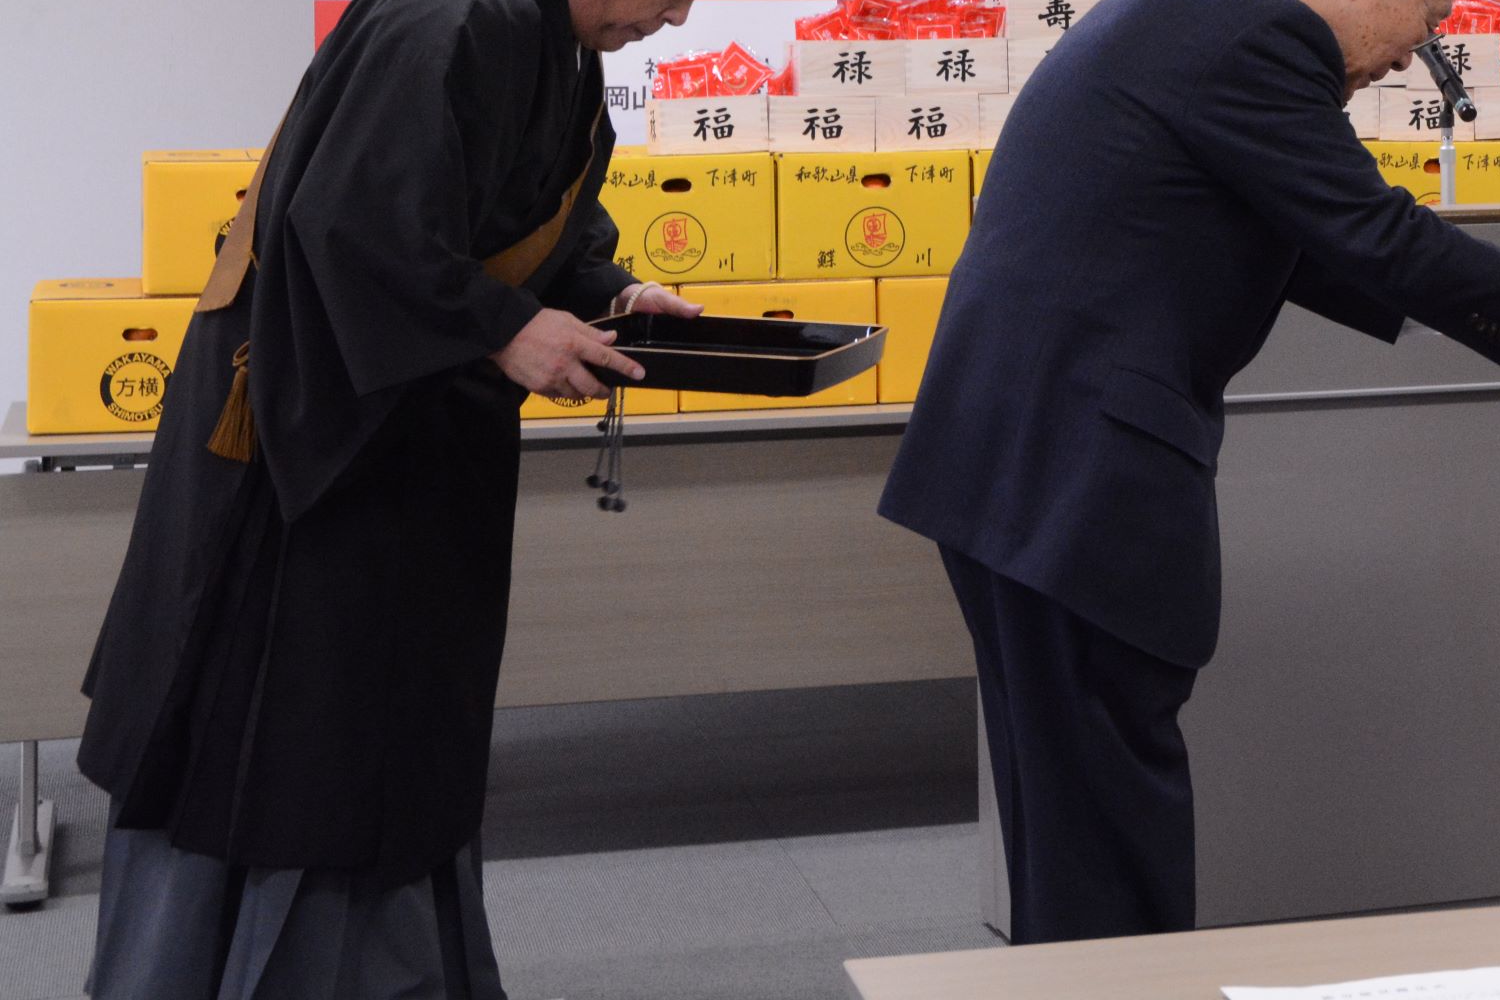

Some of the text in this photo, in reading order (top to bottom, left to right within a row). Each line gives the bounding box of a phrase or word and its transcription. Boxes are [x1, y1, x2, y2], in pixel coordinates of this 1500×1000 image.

[832, 50, 873, 85] 禄
[936, 49, 977, 83] 禄
[693, 107, 735, 142] 福
[802, 107, 844, 142] 福
[908, 106, 948, 141] 福
[795, 165, 955, 188] 和歌山県 下津町
[1375, 153, 1421, 170] 歌山県
[603, 168, 758, 188] 歌山県 下津町
[105, 352, 172, 378] WAKAYAMA
[107, 402, 163, 422] SHIMOTSU
